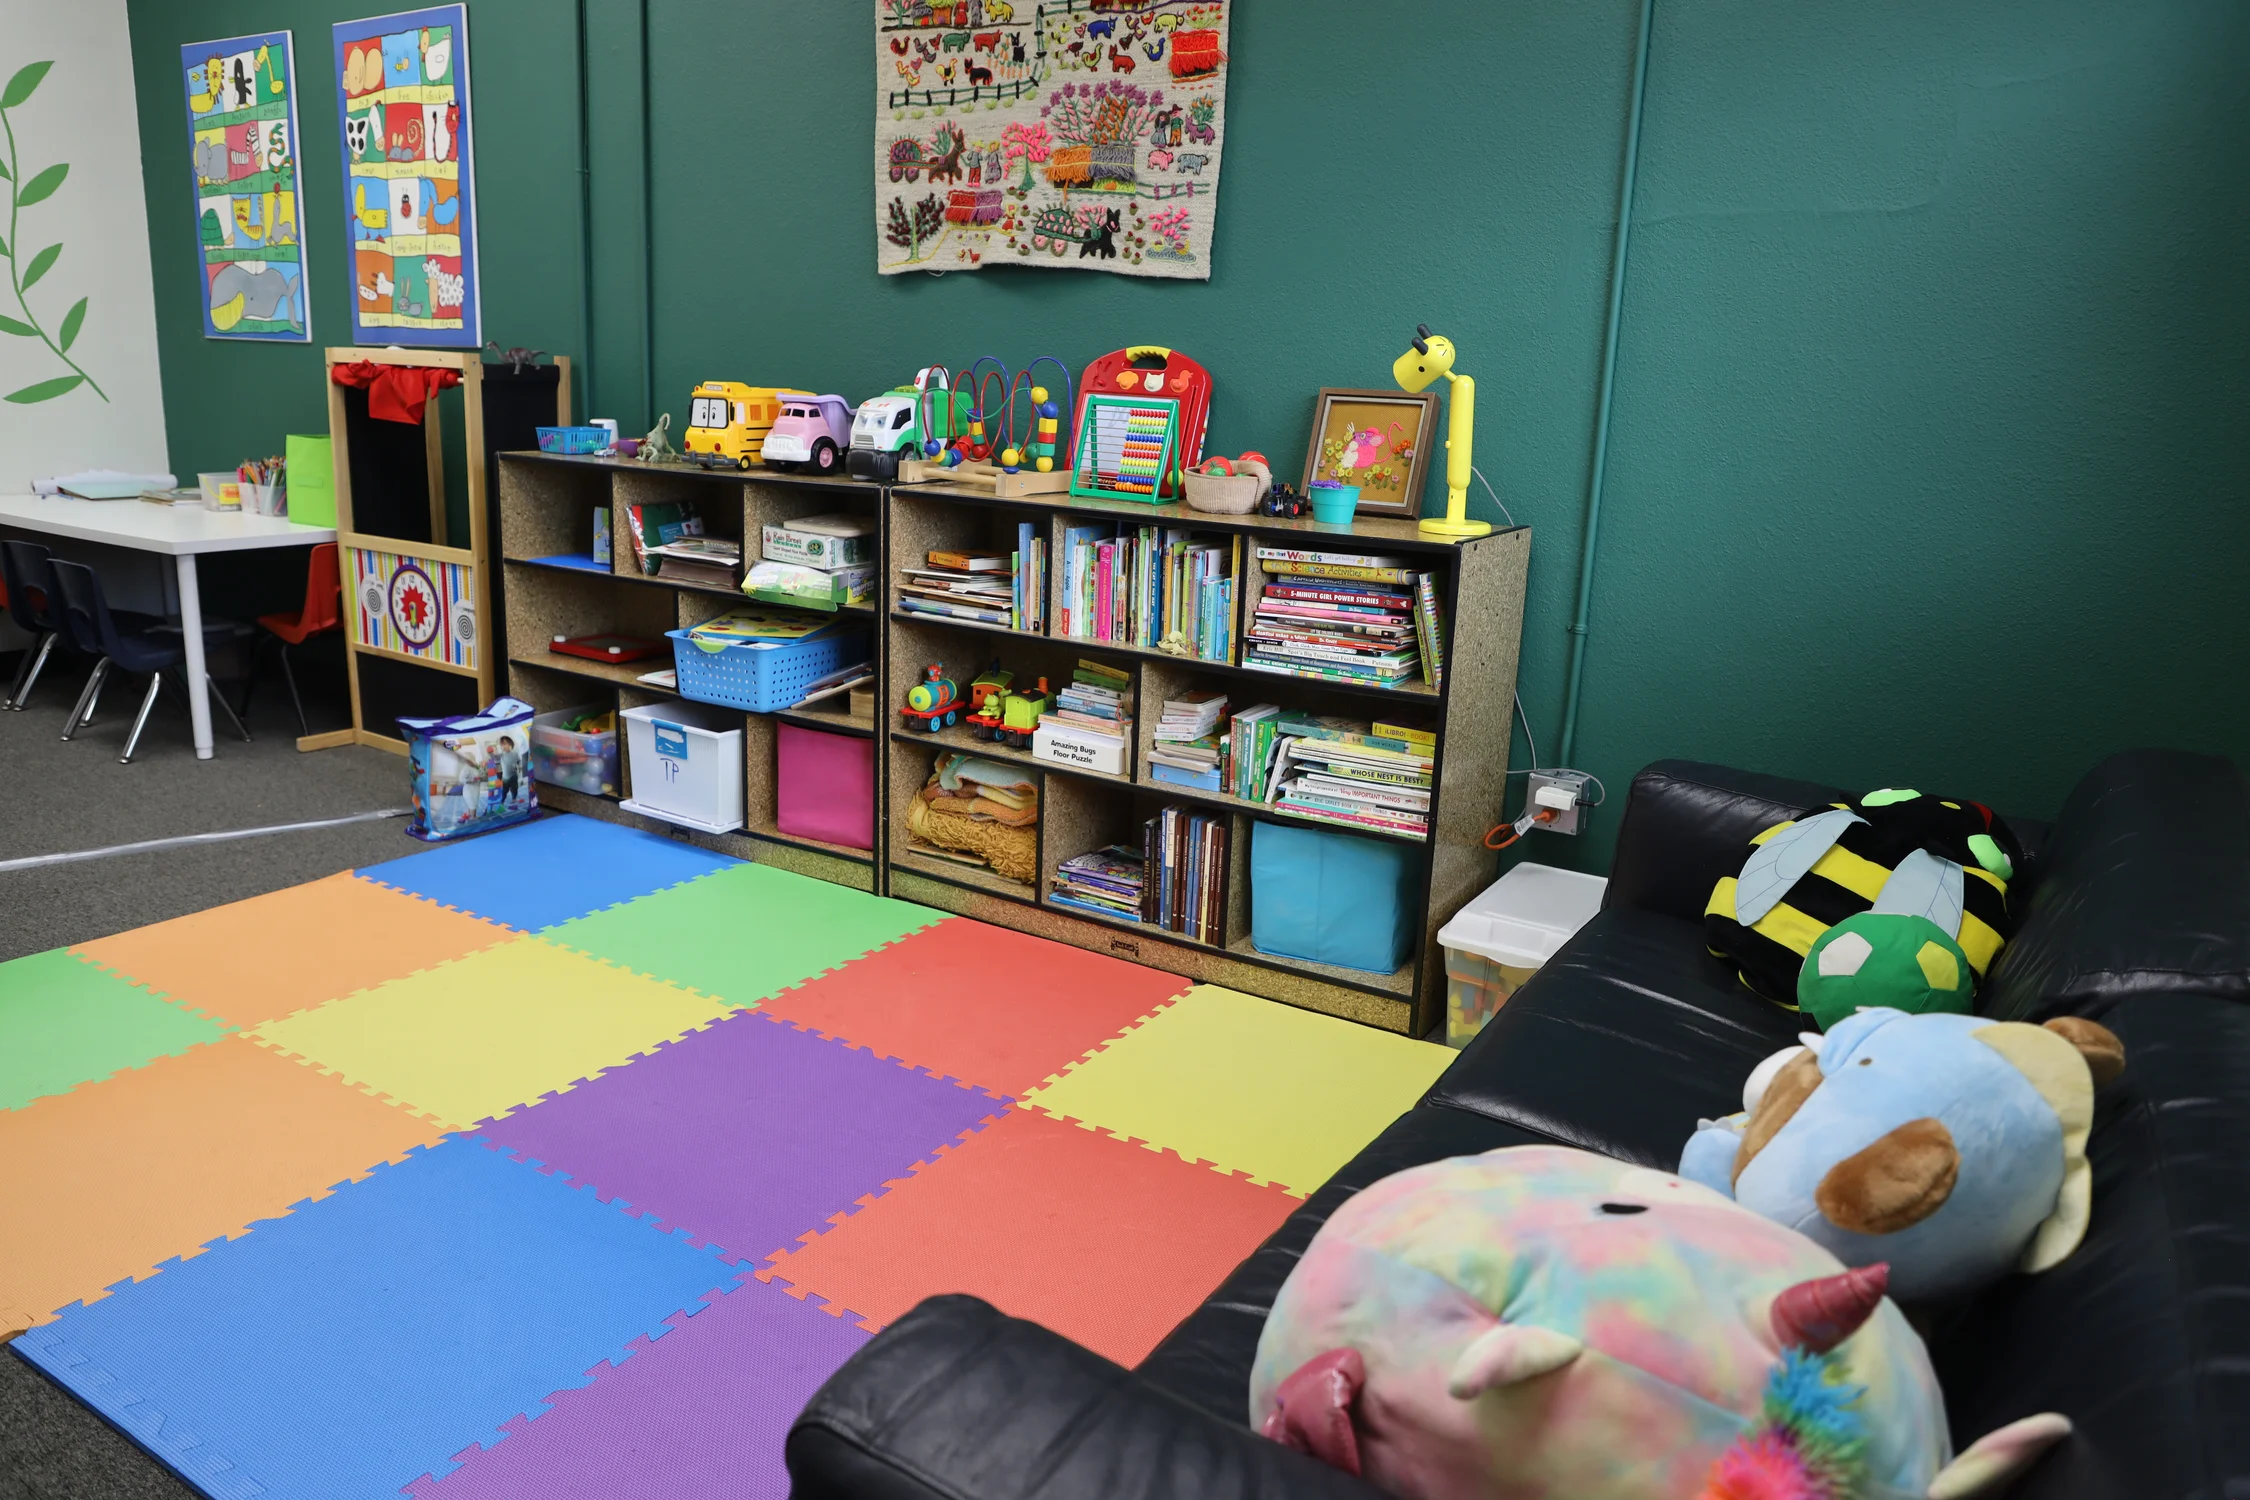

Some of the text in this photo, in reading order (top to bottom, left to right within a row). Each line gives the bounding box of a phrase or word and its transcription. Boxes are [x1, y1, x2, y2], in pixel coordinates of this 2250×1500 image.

[1287, 551, 1323, 562] Words
[1291, 561, 1325, 575] Science
[1327, 566, 1362, 578] Activities
[1290, 590, 1318, 599] 5-MINUTE
[1356, 596, 1379, 605] STORIES
[1288, 648, 1303, 656] Spot's
[1313, 651, 1329, 659] Touch
[1410, 732, 1430, 741] BOOK!
[1050, 739, 1097, 756] Amazing Bugs
[1382, 741, 1397, 749] WORLD
[1053, 749, 1093, 764] Floor Puzzle
[659, 757, 680, 784] TP
[1350, 769, 1424, 785] WHOSE NEST IS BEST?
[1340, 787, 1352, 796] Very
[1352, 790, 1381, 800] IMPORTANT
[1381, 795, 1401, 804] THINGS
